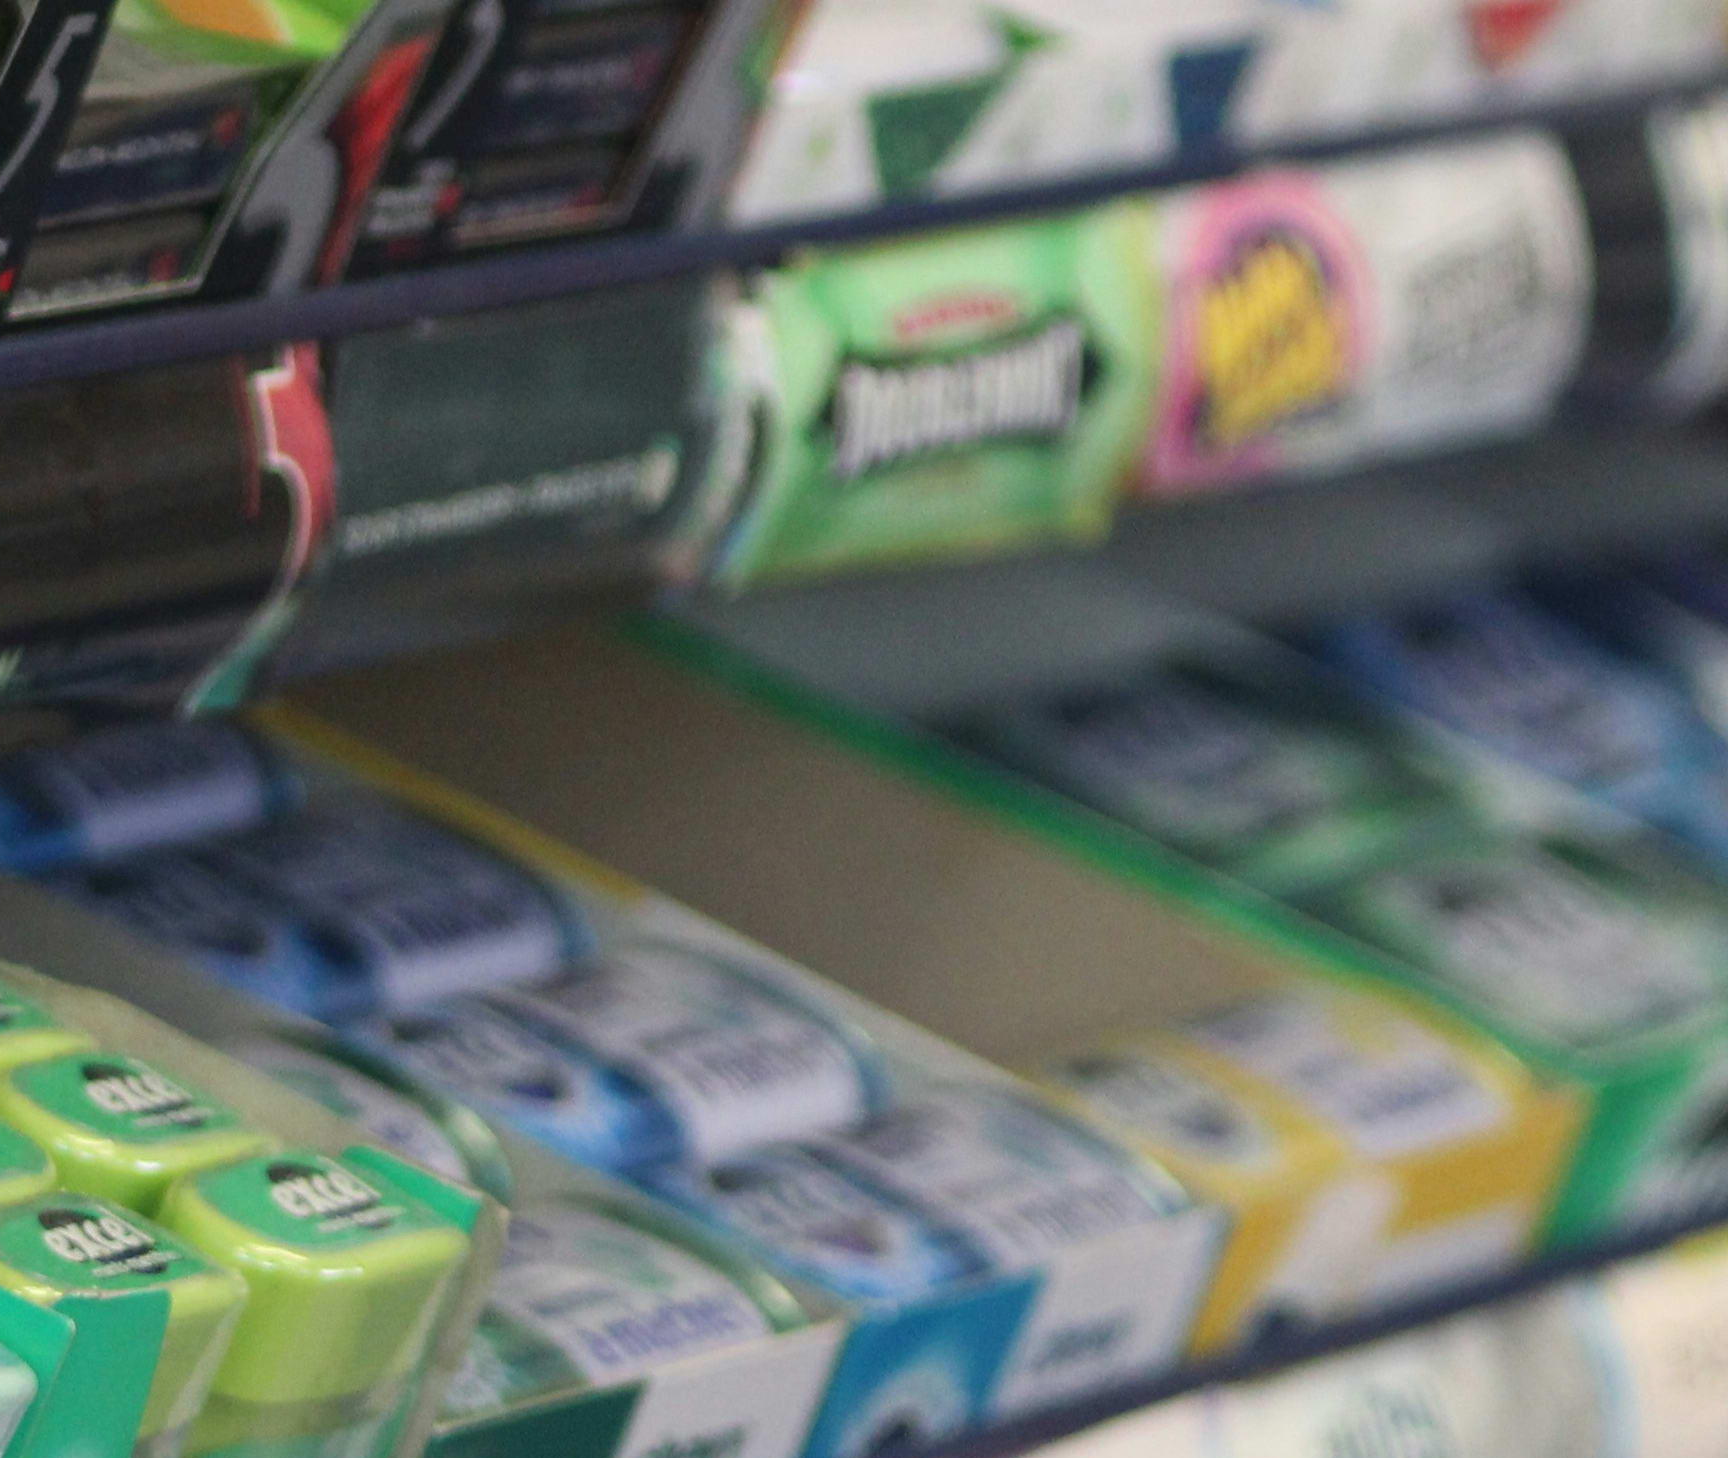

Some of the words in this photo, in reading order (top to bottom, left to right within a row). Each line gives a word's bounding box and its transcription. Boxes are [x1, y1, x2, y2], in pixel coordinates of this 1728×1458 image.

[82, 1056, 193, 1114] excel
[270, 1154, 382, 1219] excel
[43, 1201, 156, 1265] excel
